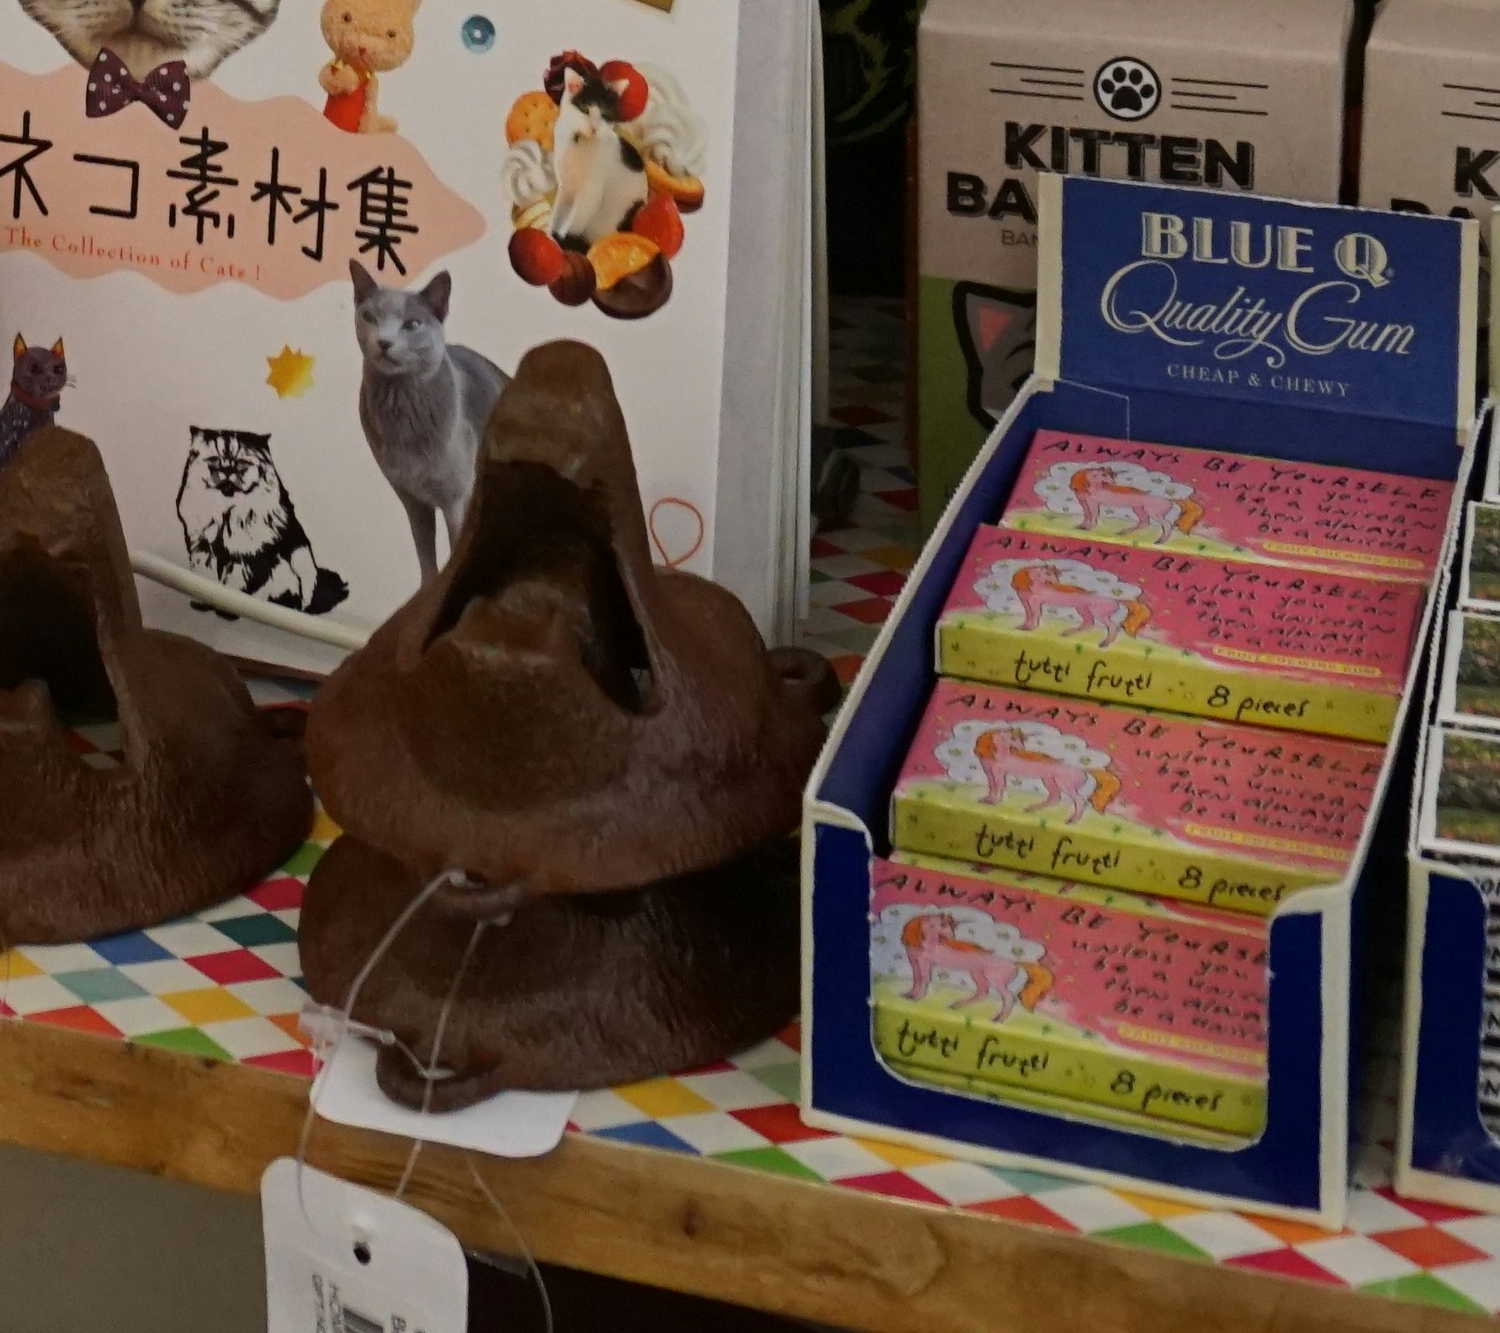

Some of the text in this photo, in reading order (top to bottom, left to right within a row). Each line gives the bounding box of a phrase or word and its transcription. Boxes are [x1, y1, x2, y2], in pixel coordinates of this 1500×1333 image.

[5, 224, 42, 249] The
[51, 234, 161, 267] Collection
[169, 252, 190, 271] of
[200, 257, 246, 279] Cats
[1140, 211, 1396, 289] BLUE Q
[1100, 258, 1416, 370] Quality Gum
[1167, 364, 1351, 398] CHEAP & CHEWY
[1041, 438, 1440, 501] ALWAYS BE YOURSELF
[995, 535, 1401, 603] ALWAYS BE YOURSELF
[1014, 649, 1311, 721] tutti frutti 8 pieces
[874, 874, 1113, 930] ALWAYS BE
